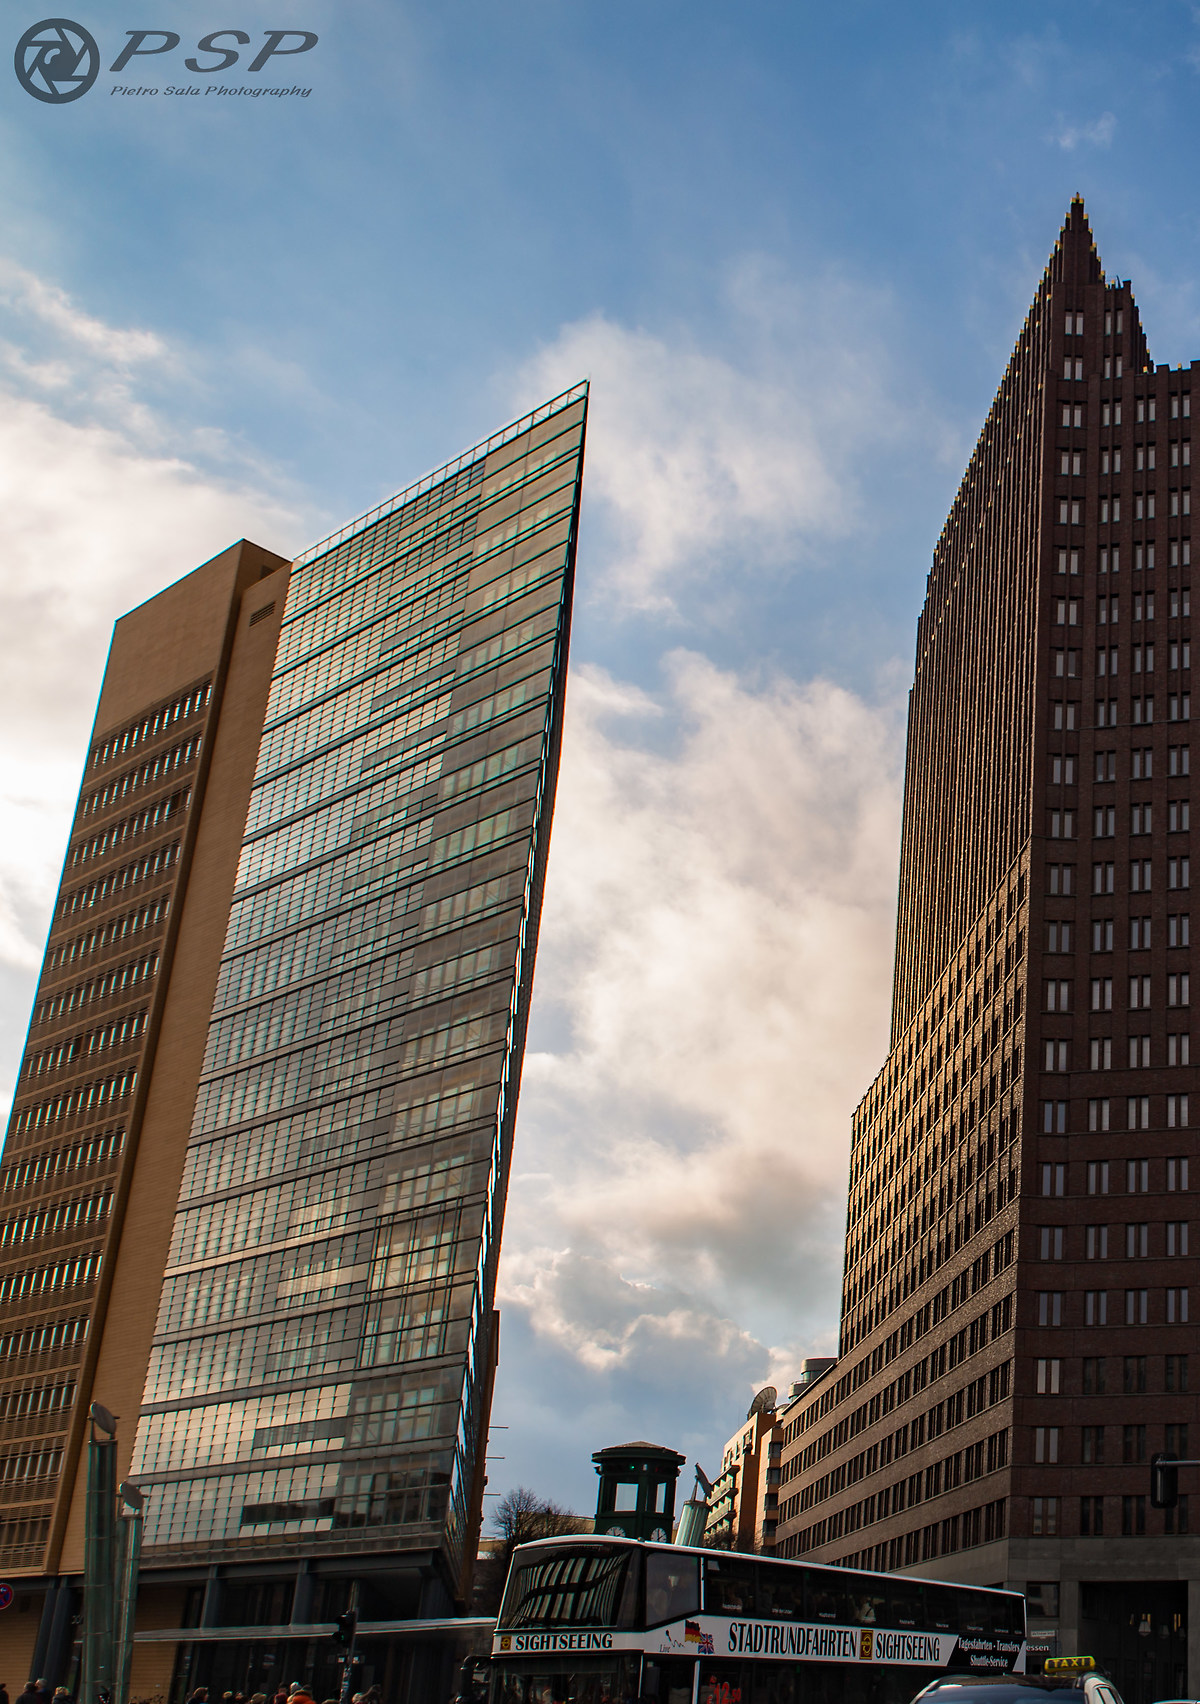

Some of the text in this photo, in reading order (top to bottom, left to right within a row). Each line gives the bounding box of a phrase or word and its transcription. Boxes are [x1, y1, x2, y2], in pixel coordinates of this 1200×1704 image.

[515, 1633, 613, 1651] SIGHTSEEING
[727, 1622, 940, 1661] STADTRUNDFAHRTEN SIGHTSEEING
[958, 1637, 1020, 1653] Tagesfahrten Transfers
[970, 1654, 1009, 1668] Shuttle-Service
[1053, 1658, 1086, 1668] TAXI
